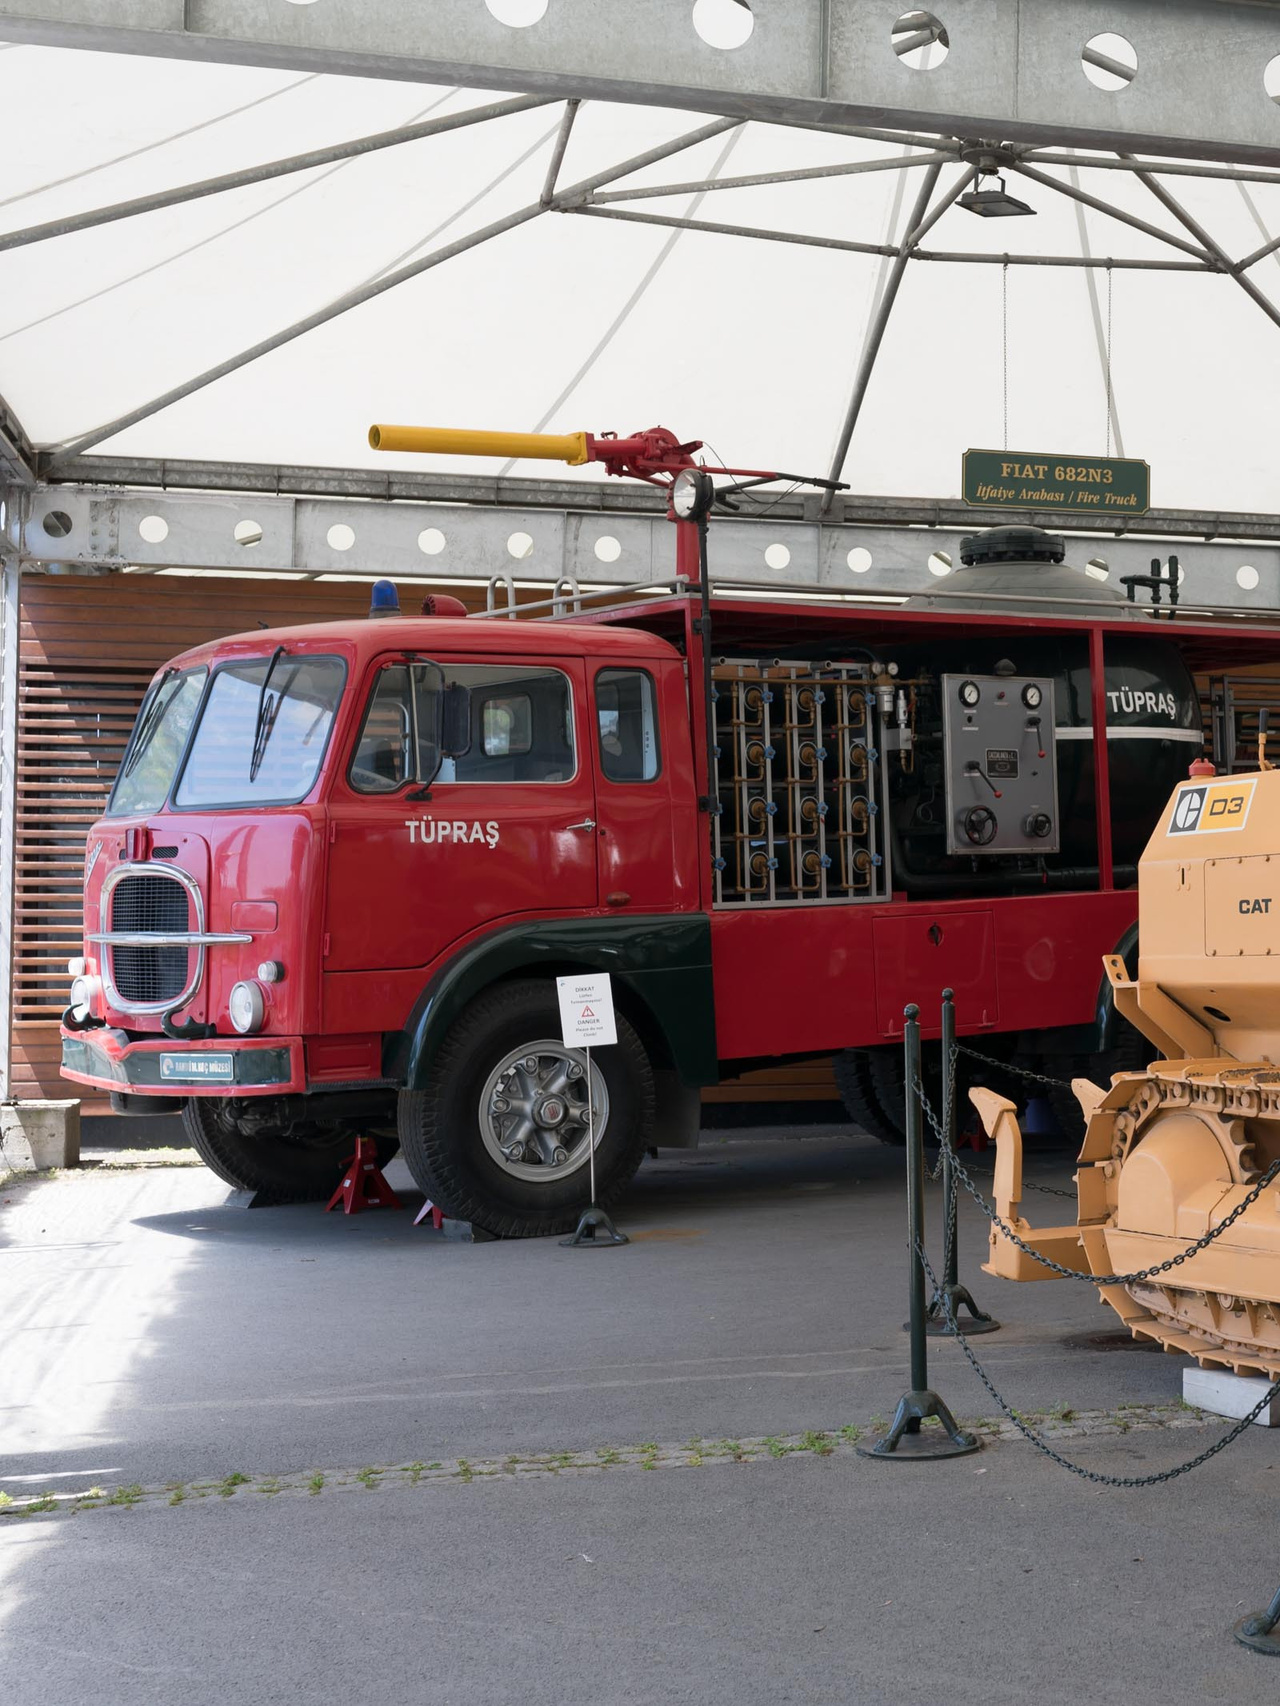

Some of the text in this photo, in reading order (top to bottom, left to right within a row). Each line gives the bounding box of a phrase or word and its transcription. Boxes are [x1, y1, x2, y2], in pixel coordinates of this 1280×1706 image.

[1001, 463, 1114, 484] FIAT 682N3
[976, 483, 1015, 500] İtfaiye
[1018, 488, 1065, 502] Arabası
[1076, 491, 1100, 503] Fire
[1104, 492, 1138, 506] Truck
[1106, 686, 1176, 720] TÜPRAŞ
[1209, 796, 1245, 816] D3
[405, 815, 500, 850] TÜPRAŞ
[1238, 898, 1272, 914] CAT
